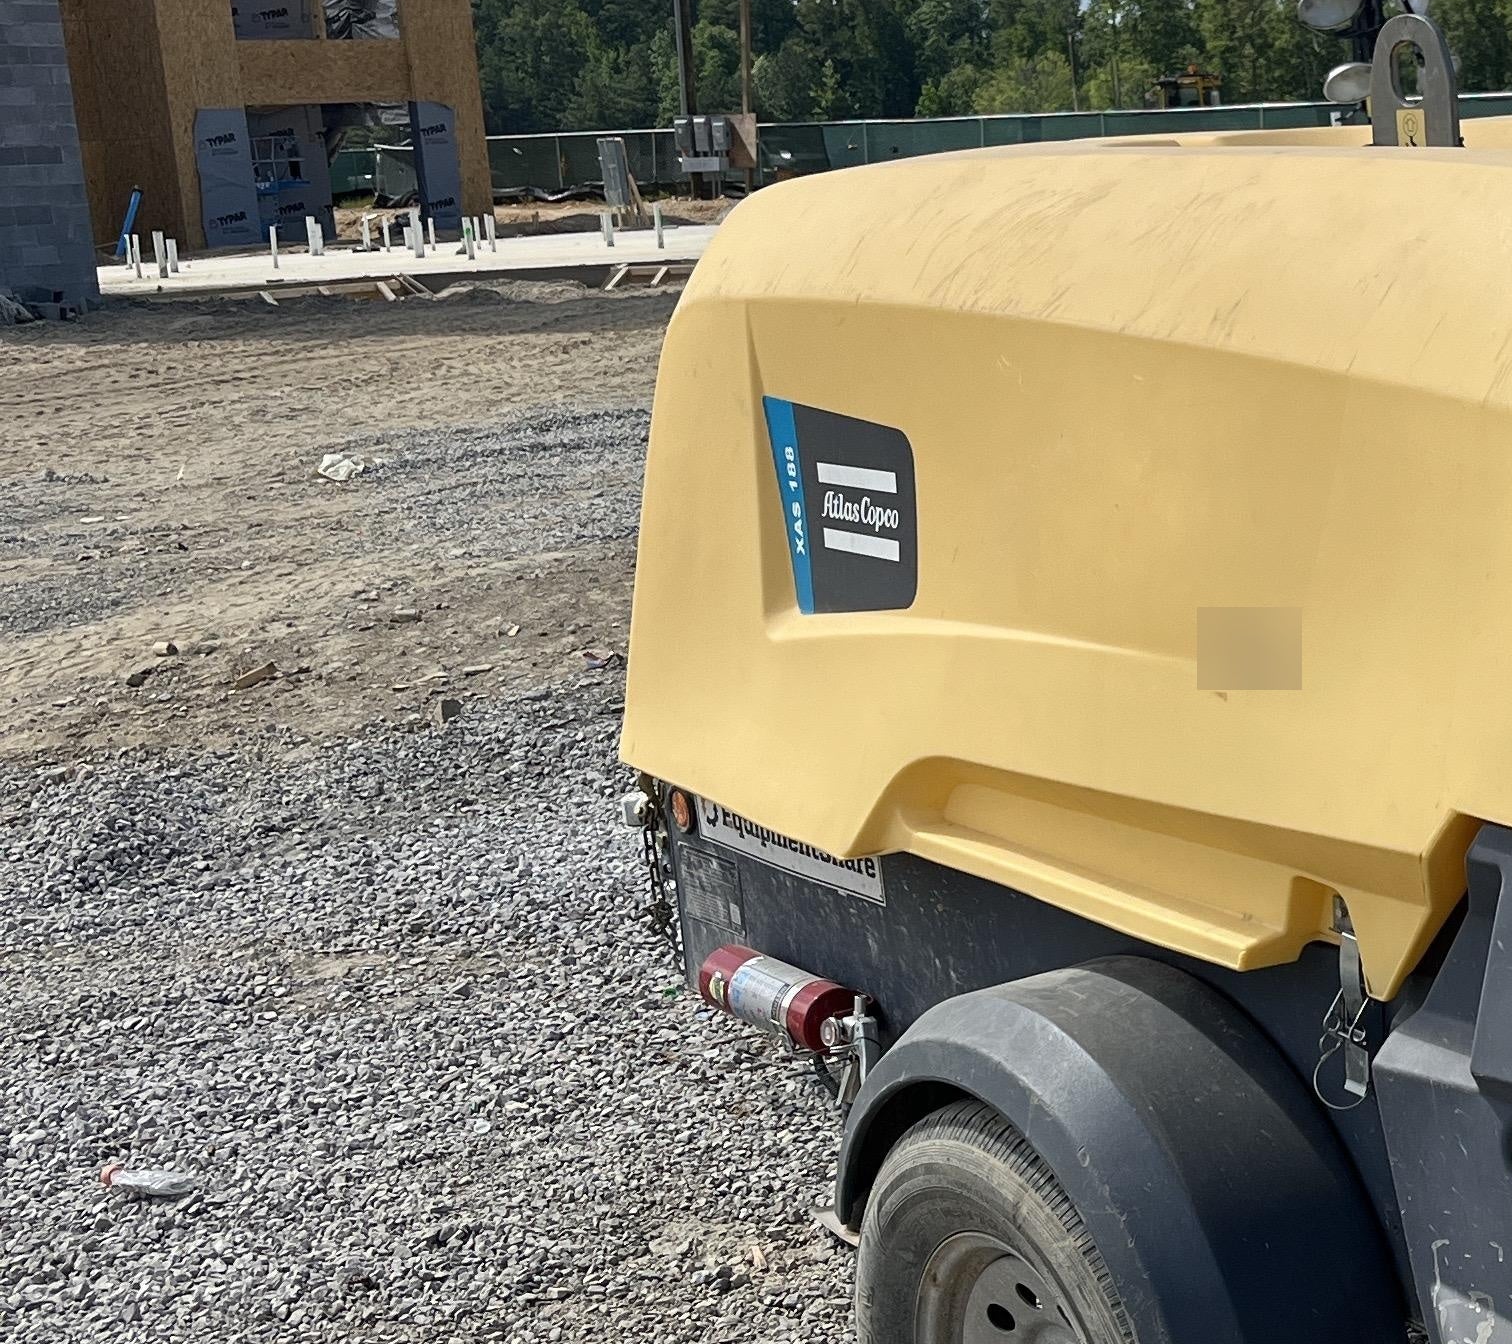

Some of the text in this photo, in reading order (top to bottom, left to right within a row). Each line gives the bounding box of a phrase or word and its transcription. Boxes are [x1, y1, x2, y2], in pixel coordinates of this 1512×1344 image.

[421, 123, 447, 137] TYPAR
[205, 132, 237, 148] TYPAR
[428, 196, 456, 211] TYPAR
[216, 210, 248, 227] TYPAR
[784, 446, 806, 556] XAS 188
[821, 490, 899, 532] Atlas Copco
